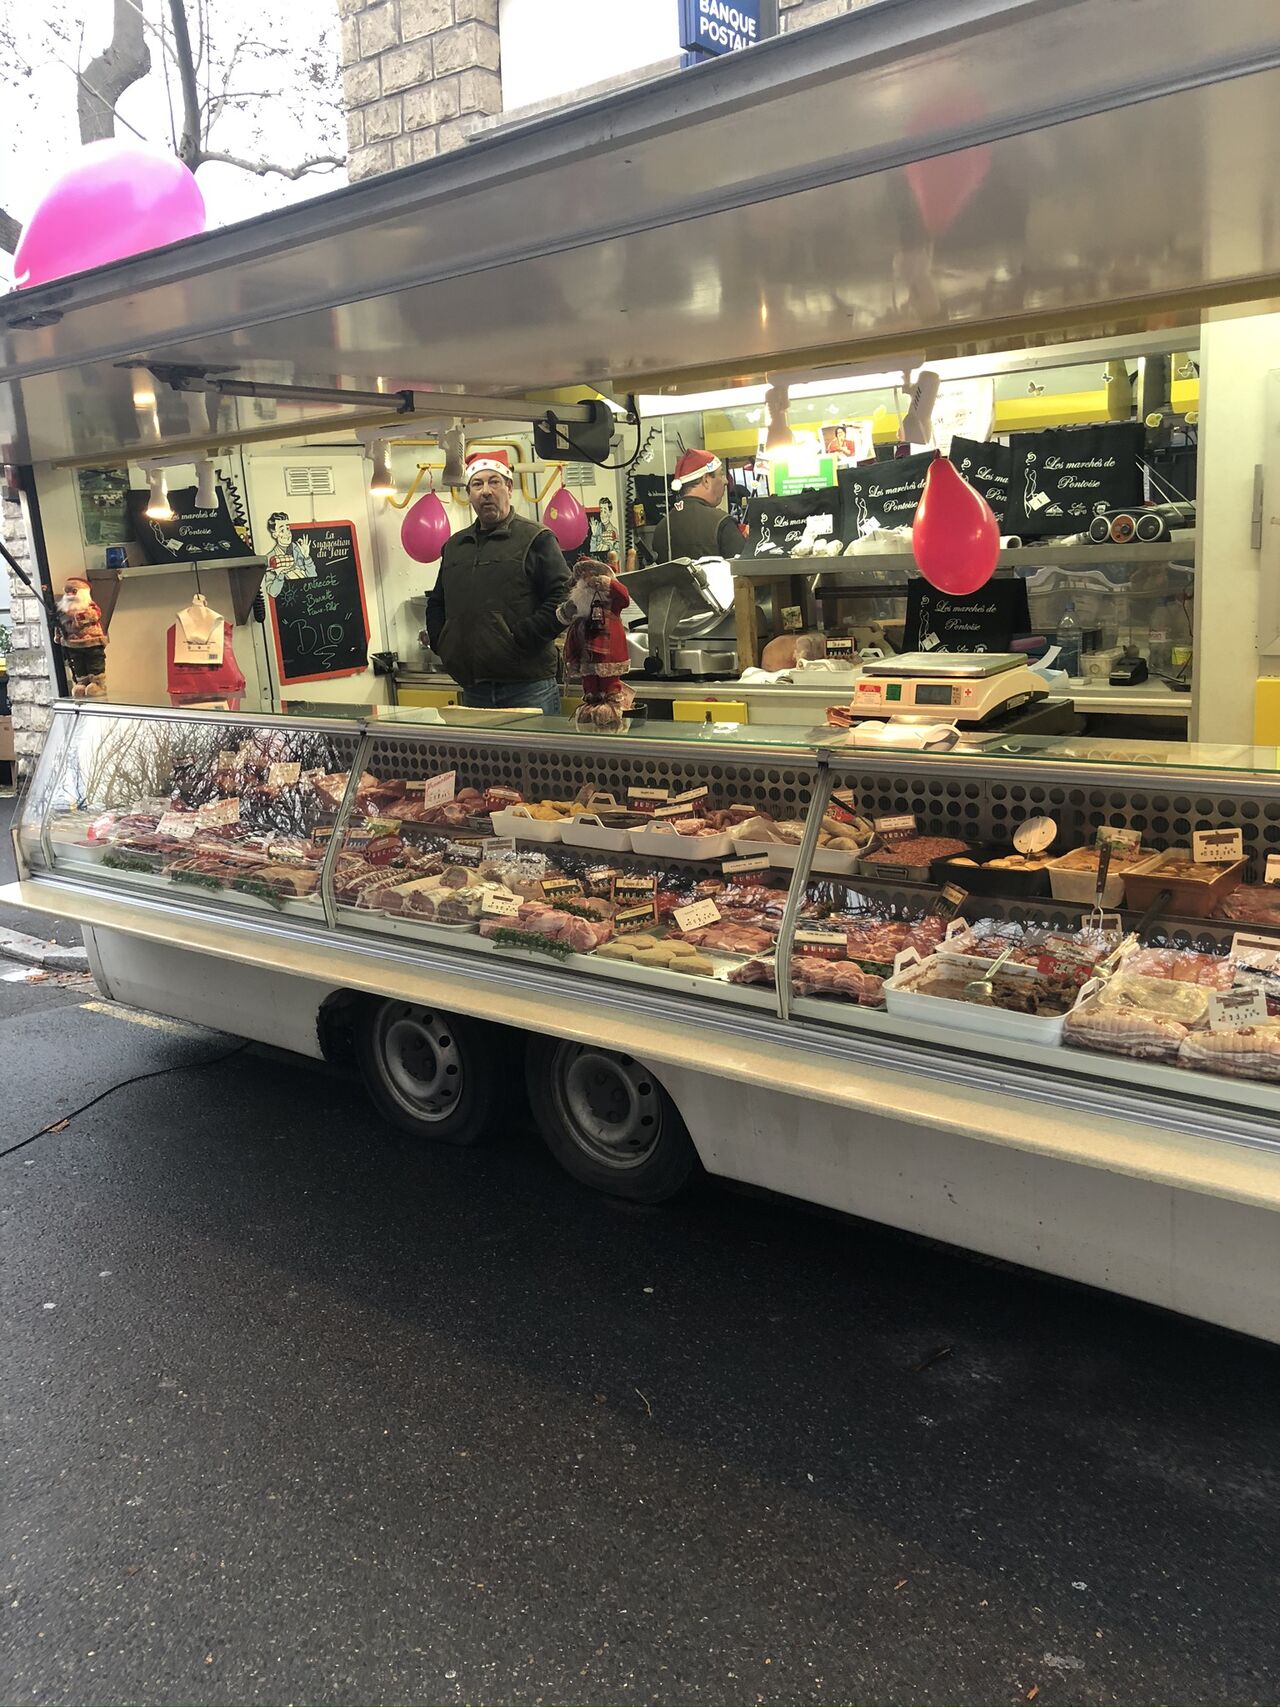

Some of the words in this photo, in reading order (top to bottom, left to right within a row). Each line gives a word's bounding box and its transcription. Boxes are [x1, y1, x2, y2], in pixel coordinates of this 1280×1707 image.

[700, 0, 757, 38] BANQUE
[1043, 457, 1063, 470] Les
[1104, 457, 1115, 467] de
[975, 466, 993, 481] Les
[1057, 475, 1100, 489] Pontoise
[869, 485, 883, 497] Les
[325, 530, 335, 540] La
[312, 539, 351, 552] Suggestion
[317, 548, 327, 558] du
[328, 547, 349, 559] Jour
[934, 600, 951, 613] Les
[986, 602, 996, 612] de
[945, 618, 981, 631] Pontoise
